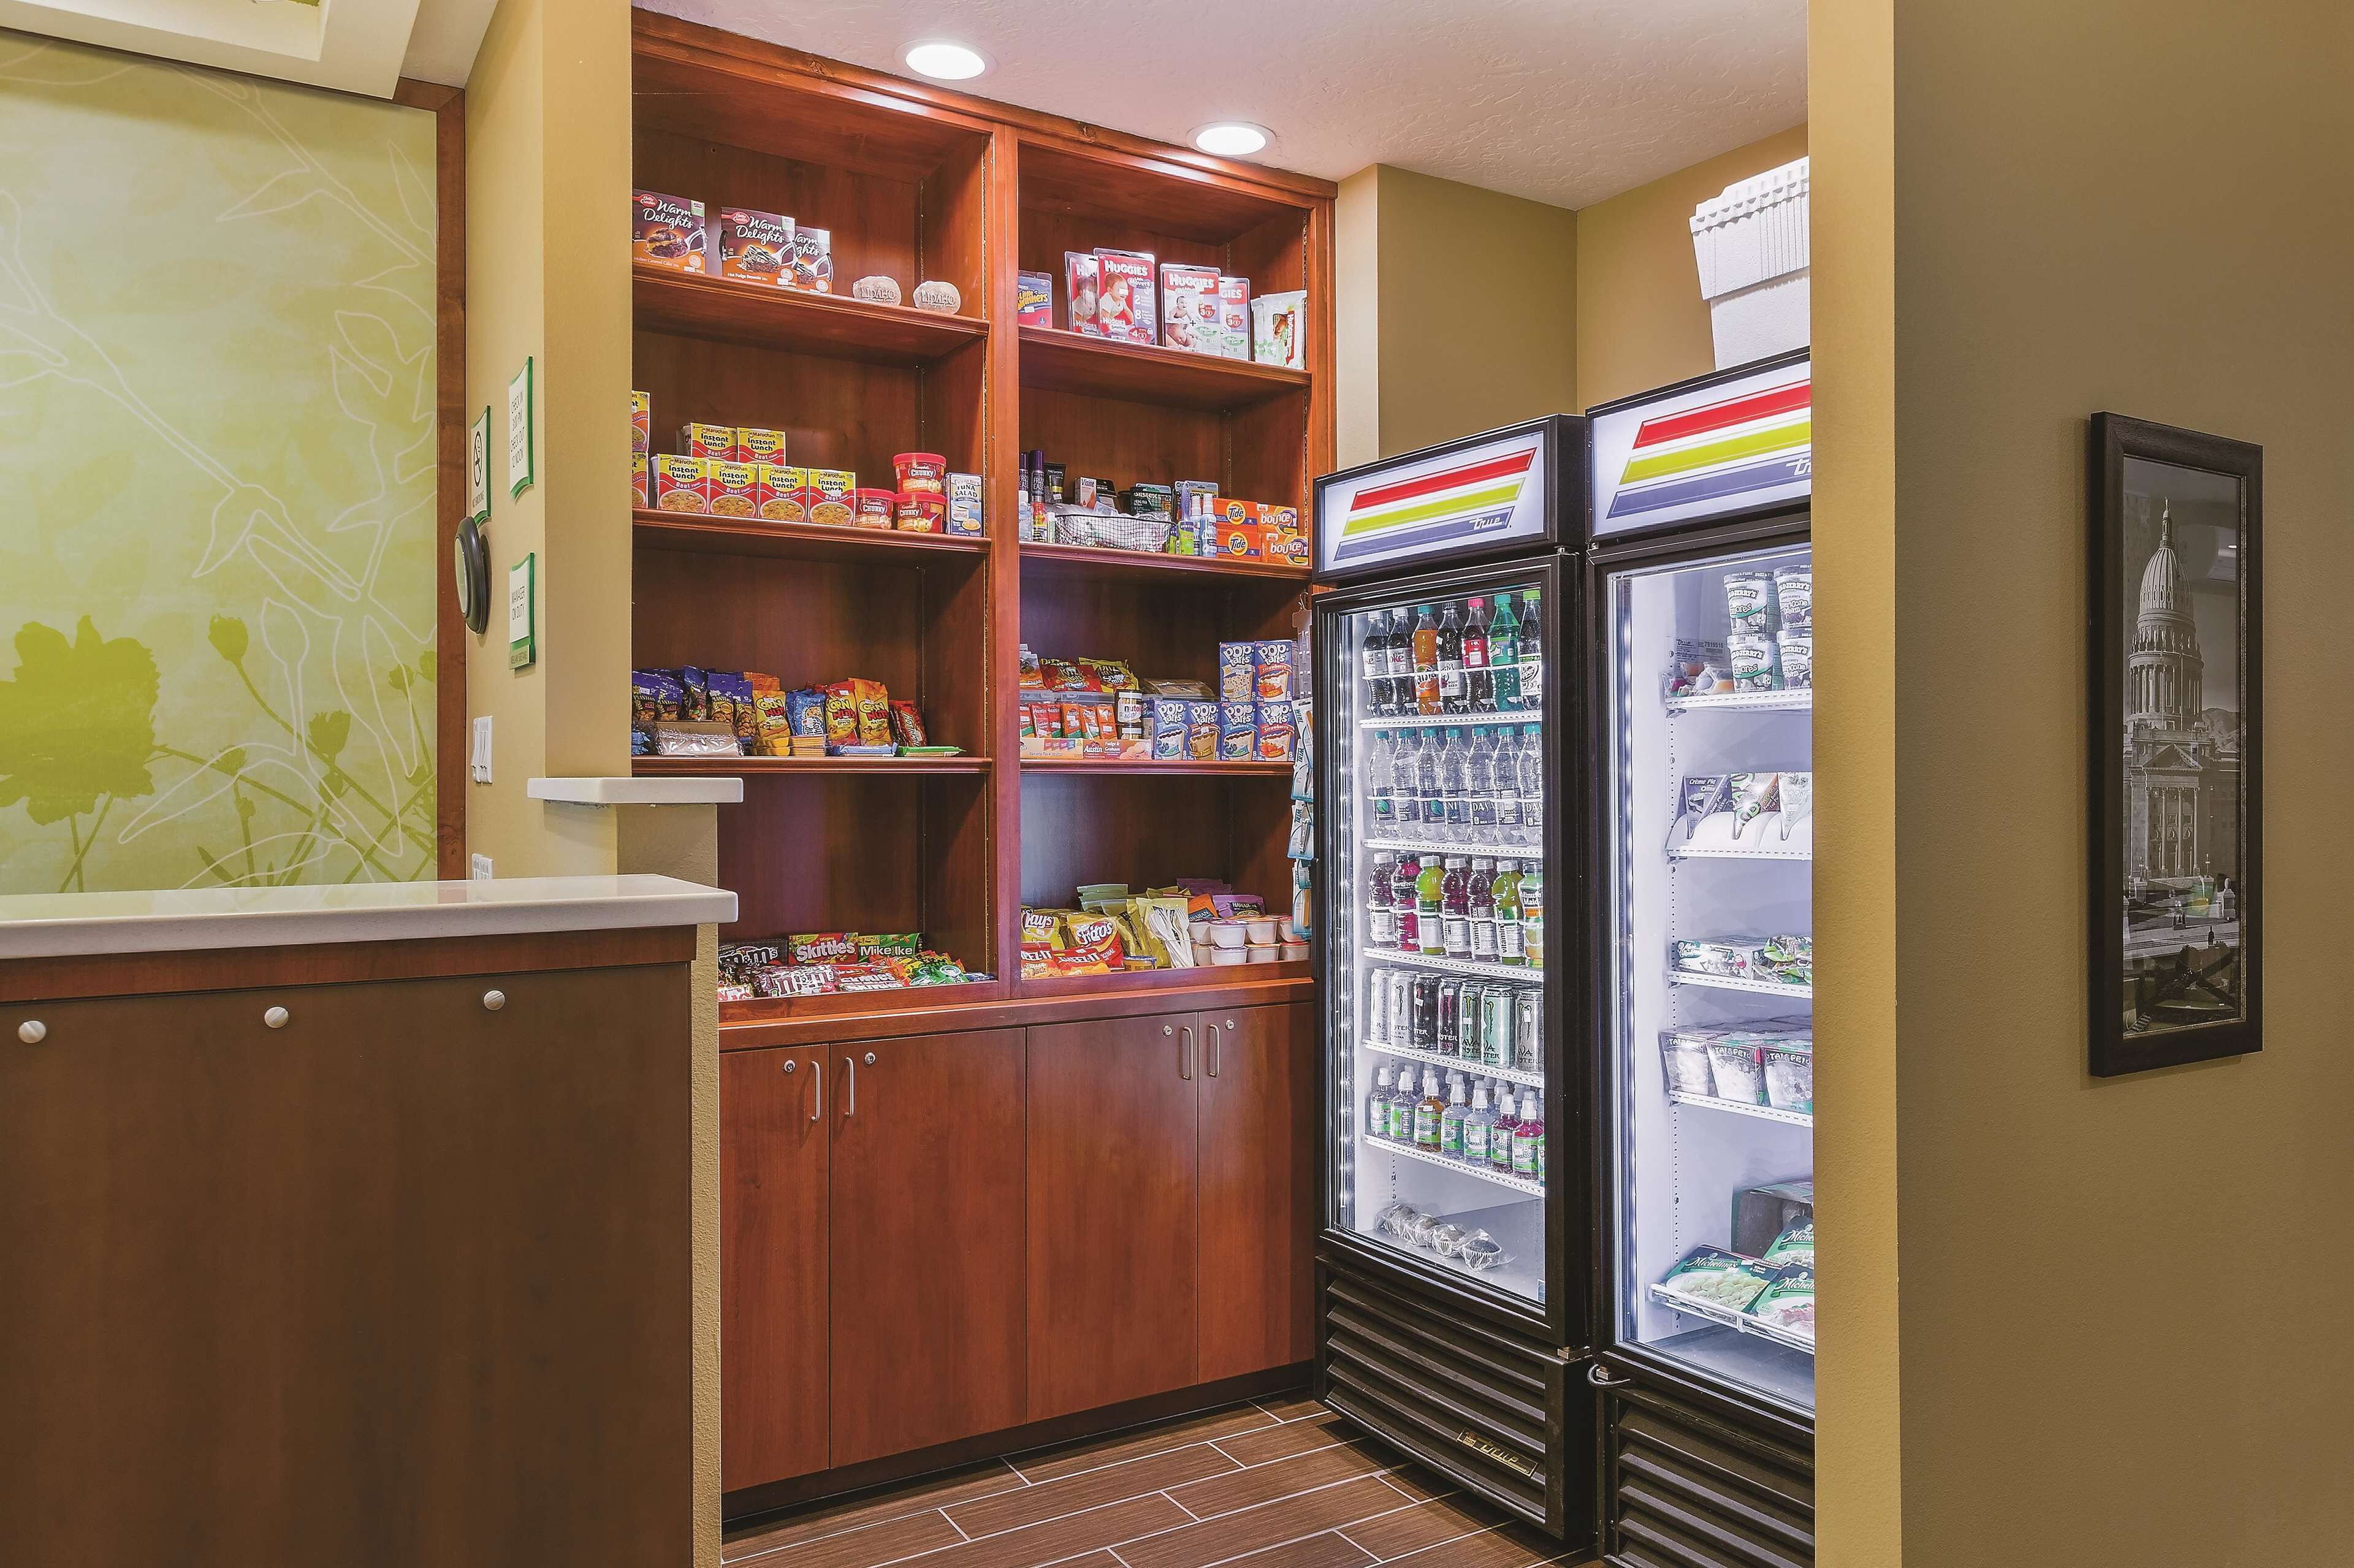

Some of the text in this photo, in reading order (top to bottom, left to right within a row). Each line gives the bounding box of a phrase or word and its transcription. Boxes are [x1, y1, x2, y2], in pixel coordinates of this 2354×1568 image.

[657, 199, 692, 217] Warm
[643, 208, 693, 229] Delights
[749, 216, 783, 232] Warm
[736, 225, 785, 245] Delights
[1105, 260, 1148, 276] HUGGIES
[928, 292, 955, 304] IDAHO
[701, 433, 728, 442] Instant
[668, 465, 699, 474] Instant
[911, 469, 934, 478] CHUNKY
[1081, 478, 1094, 487] Visine
[863, 504, 885, 513] CHUNKY
[1228, 507, 1244, 519] Tide
[1260, 512, 1290, 525] bounce
[1469, 516, 1504, 530] true
[1230, 537, 1246, 550] Tide
[1270, 542, 1300, 554] bounce
[511, 585, 525, 603] MANAGER
[1229, 655, 1251, 666] tarts
[1265, 655, 1286, 665] tarts
[756, 698, 784, 710] CORN
[828, 699, 851, 712] CORN
[859, 701, 886, 713] CORN
[1163, 714, 1183, 724] tarts
[1196, 715, 1215, 725] tarts
[1230, 714, 1251, 725] tarts
[1267, 714, 1288, 725] tarts
[1294, 709, 1303, 724] TRIM
[1025, 912, 1054, 928] Lay's
[1076, 921, 1113, 945] Fritos
[796, 940, 855, 961] Skittles
[860, 946, 913, 956] Mike Ike
[1058, 953, 1102, 963] CHEEZ-IT
